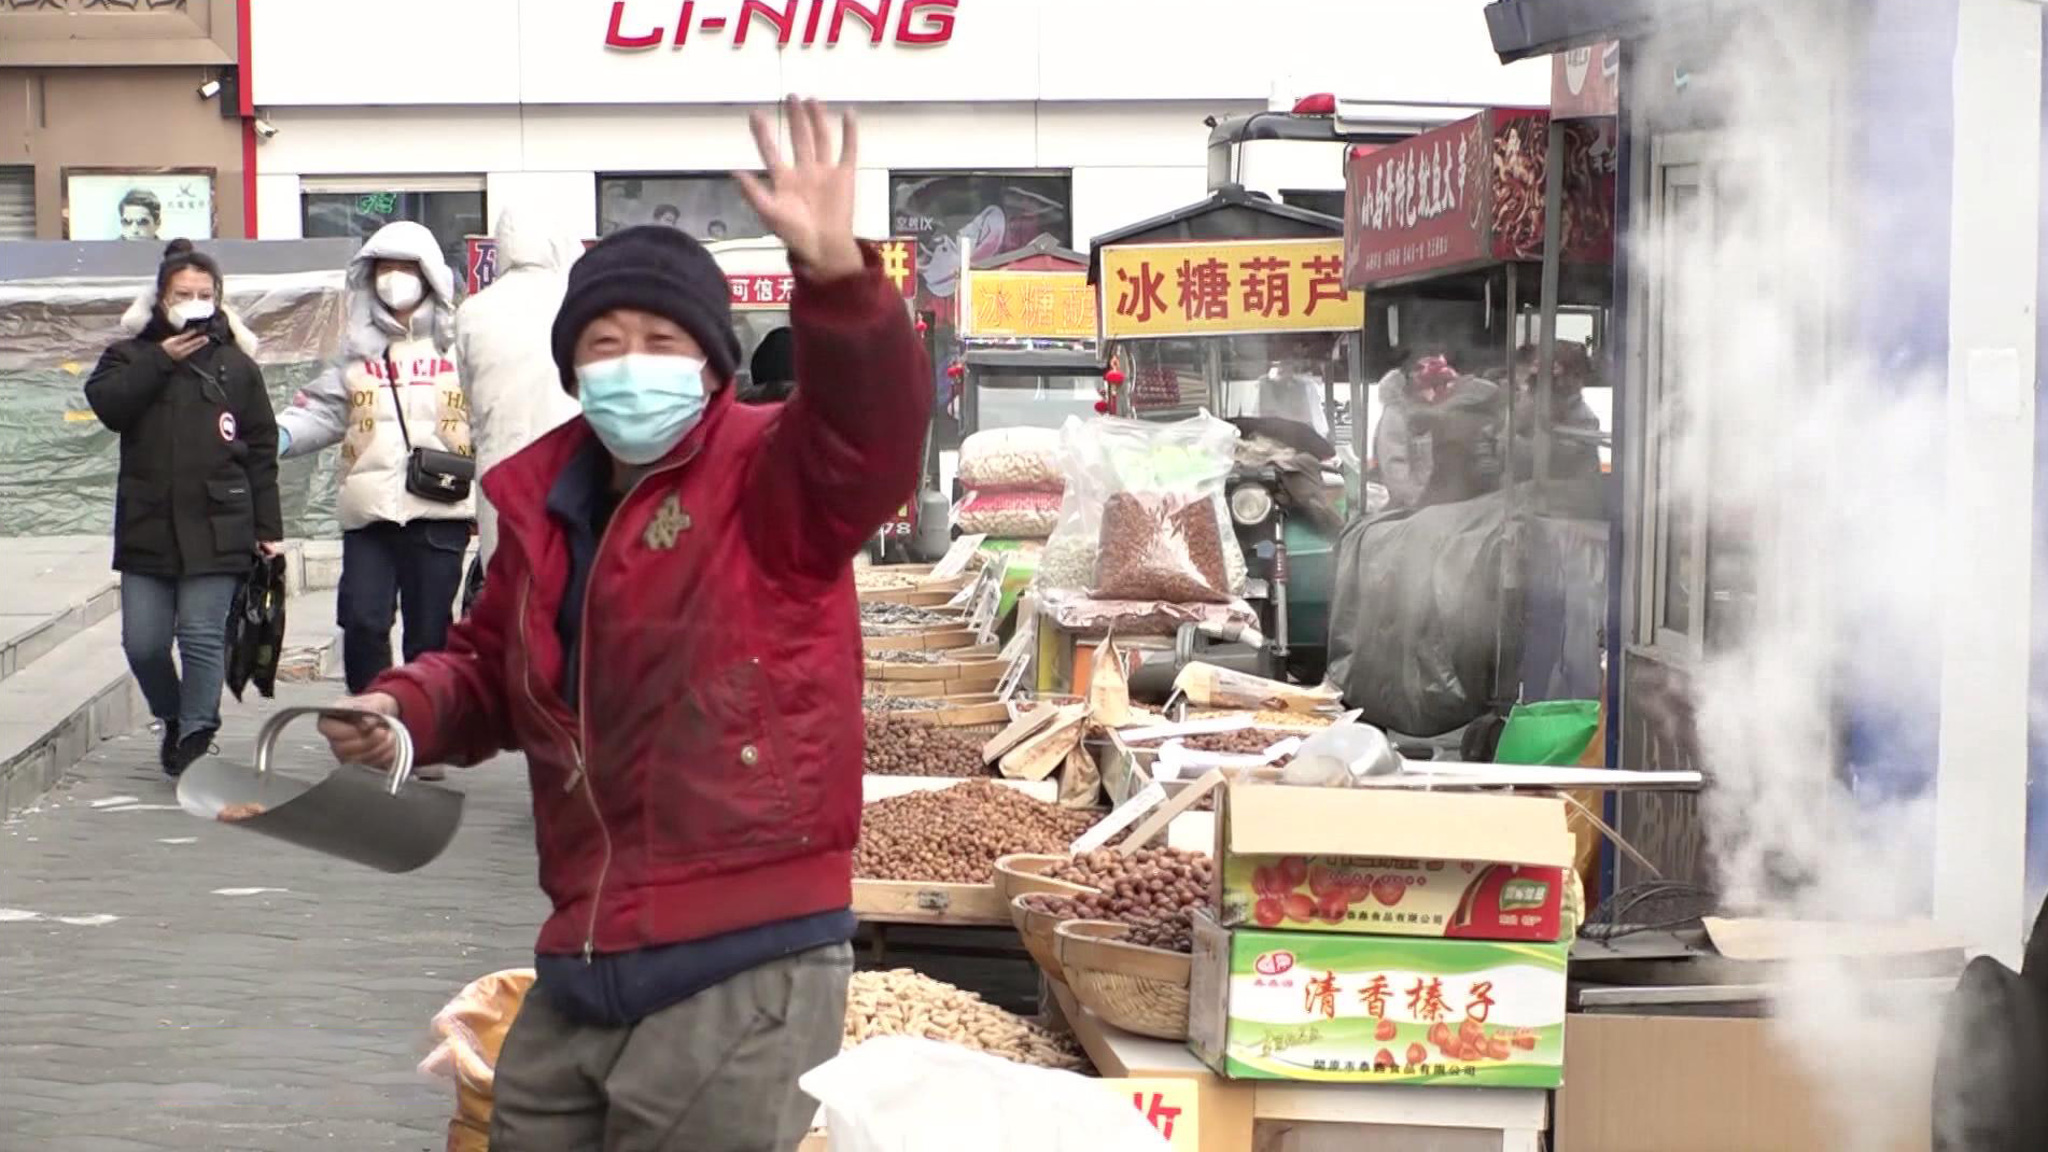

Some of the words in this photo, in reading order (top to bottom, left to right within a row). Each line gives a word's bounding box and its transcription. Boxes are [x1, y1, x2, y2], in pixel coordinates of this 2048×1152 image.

[603, 0, 959, 50] LI-NING
[1116, 255, 1348, 322] 冰糖葫芦
[1304, 970, 1495, 1024] 清香榛子
